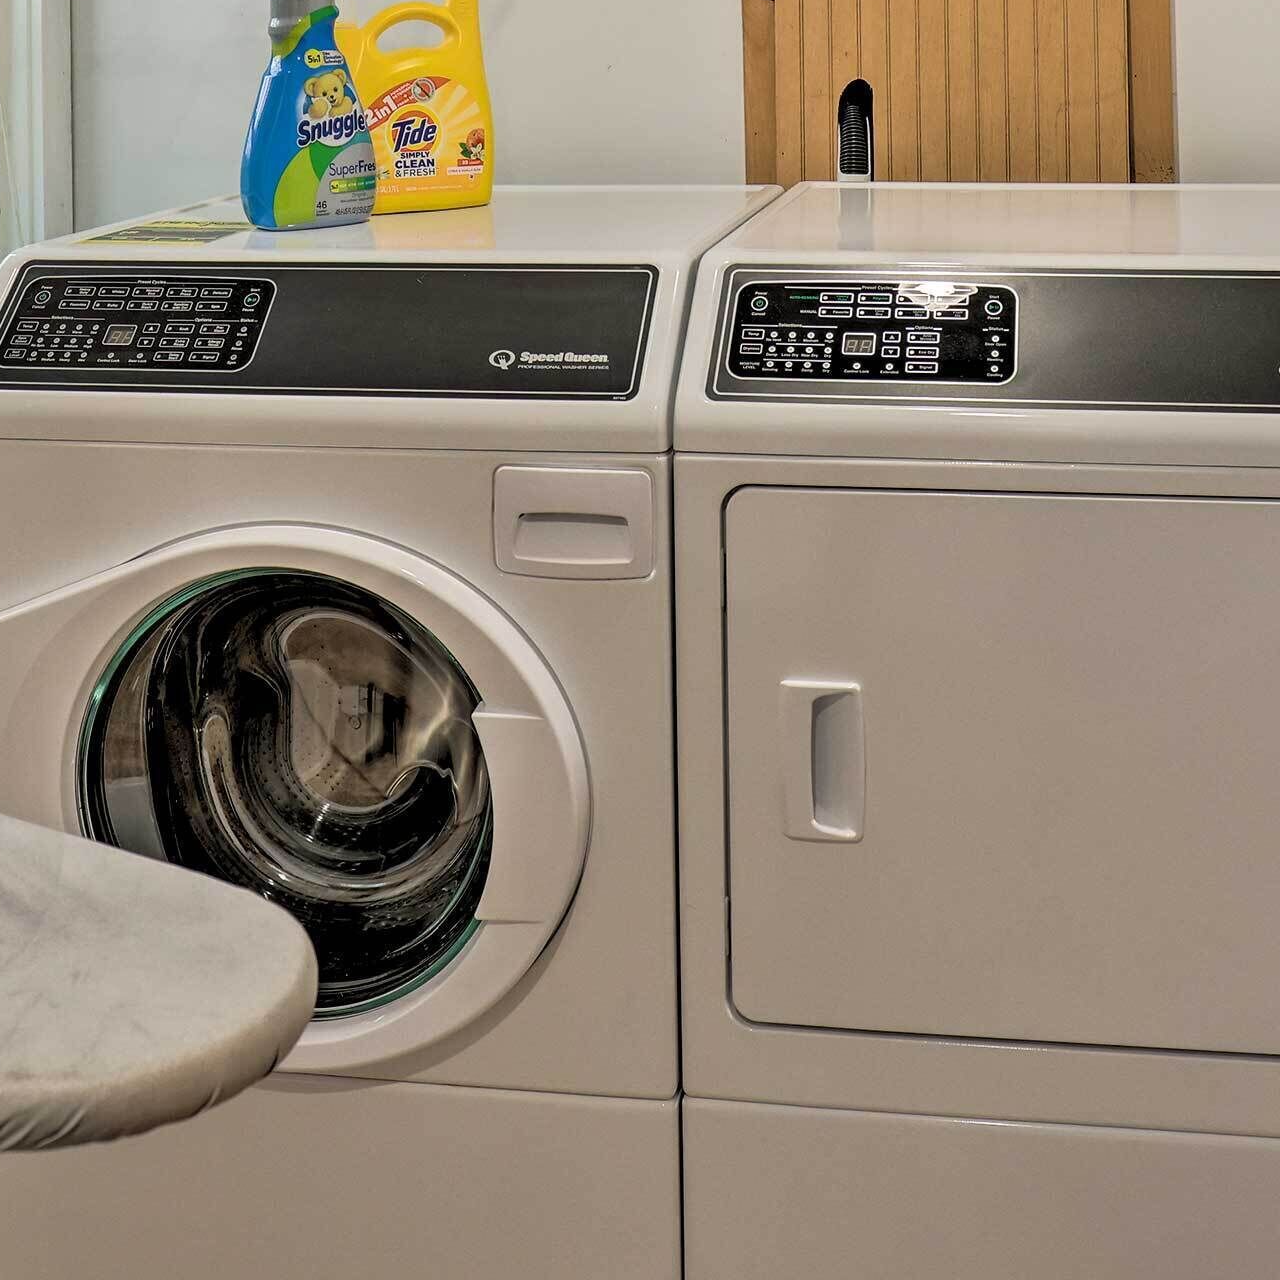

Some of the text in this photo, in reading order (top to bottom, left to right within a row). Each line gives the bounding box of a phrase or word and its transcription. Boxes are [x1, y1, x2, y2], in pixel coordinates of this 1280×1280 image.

[298, 110, 365, 146] Snuggle
[392, 117, 437, 152] Tide
[329, 160, 376, 178] SuperFres
[395, 159, 435, 168] CLEAN
[404, 168, 435, 176] FRESH
[317, 201, 327, 209] 46
[520, 352, 564, 364] Speed
